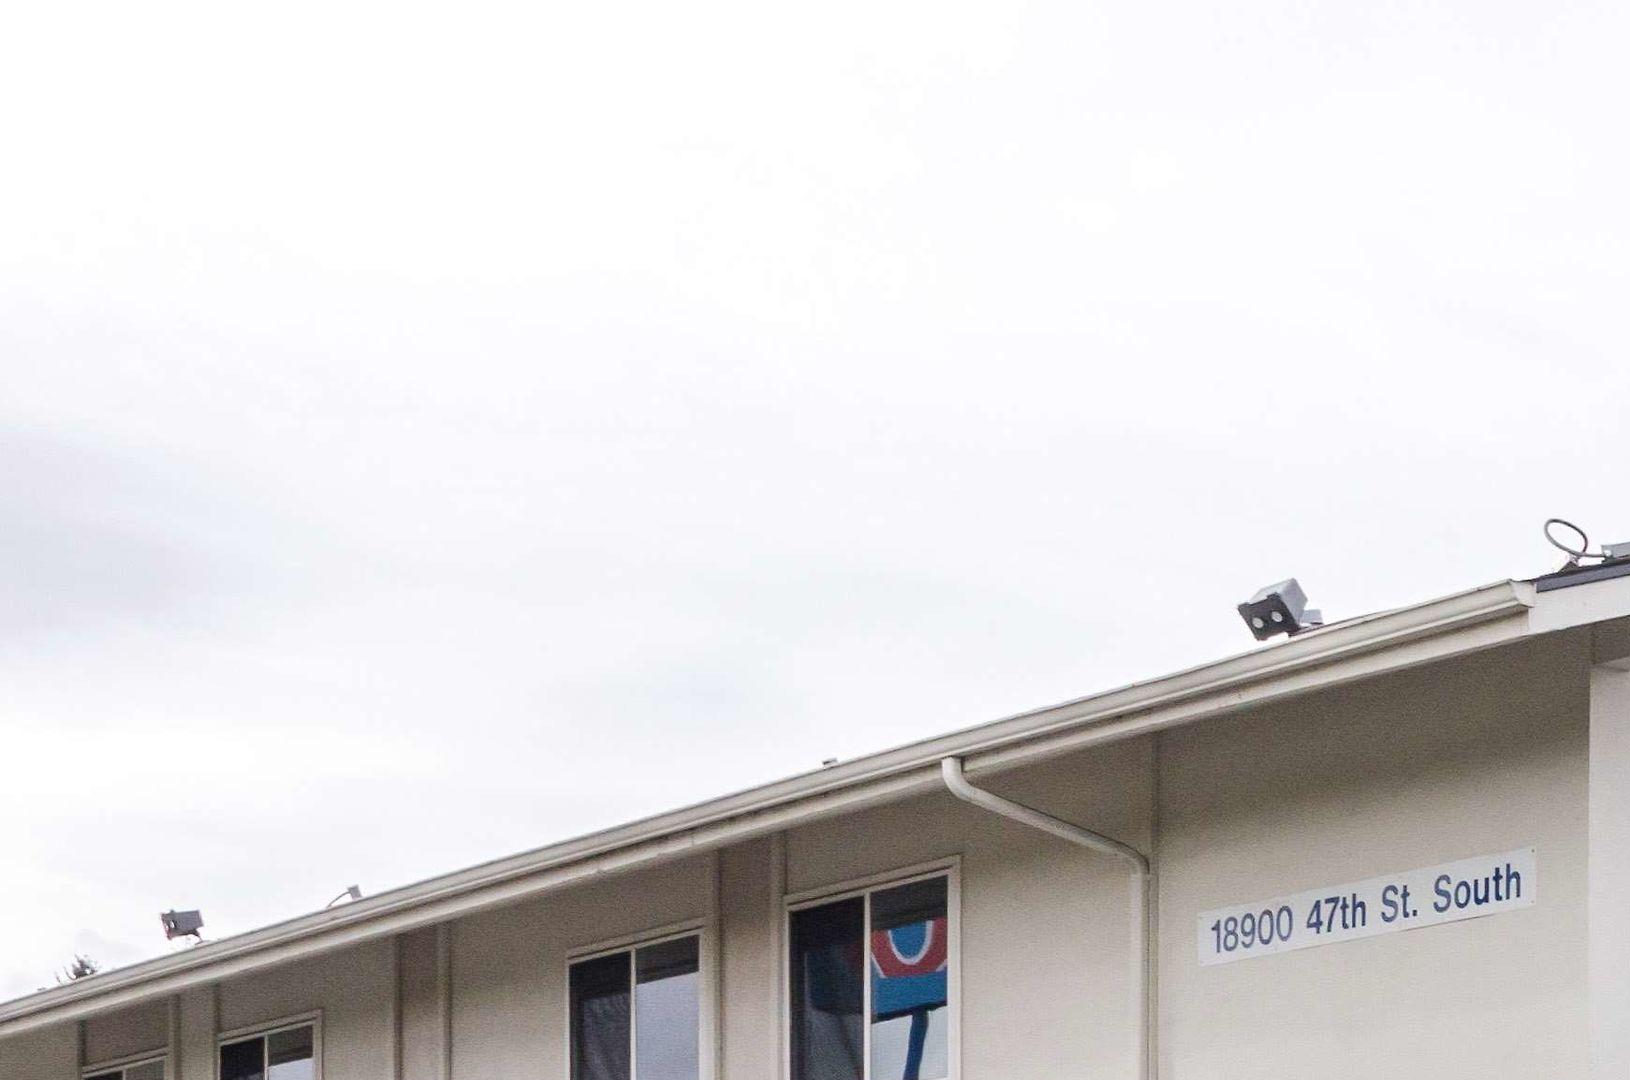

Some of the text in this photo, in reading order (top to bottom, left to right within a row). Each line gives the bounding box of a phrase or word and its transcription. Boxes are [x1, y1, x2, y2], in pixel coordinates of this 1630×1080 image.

[1211, 863, 1522, 953] 18900 47th St. South
